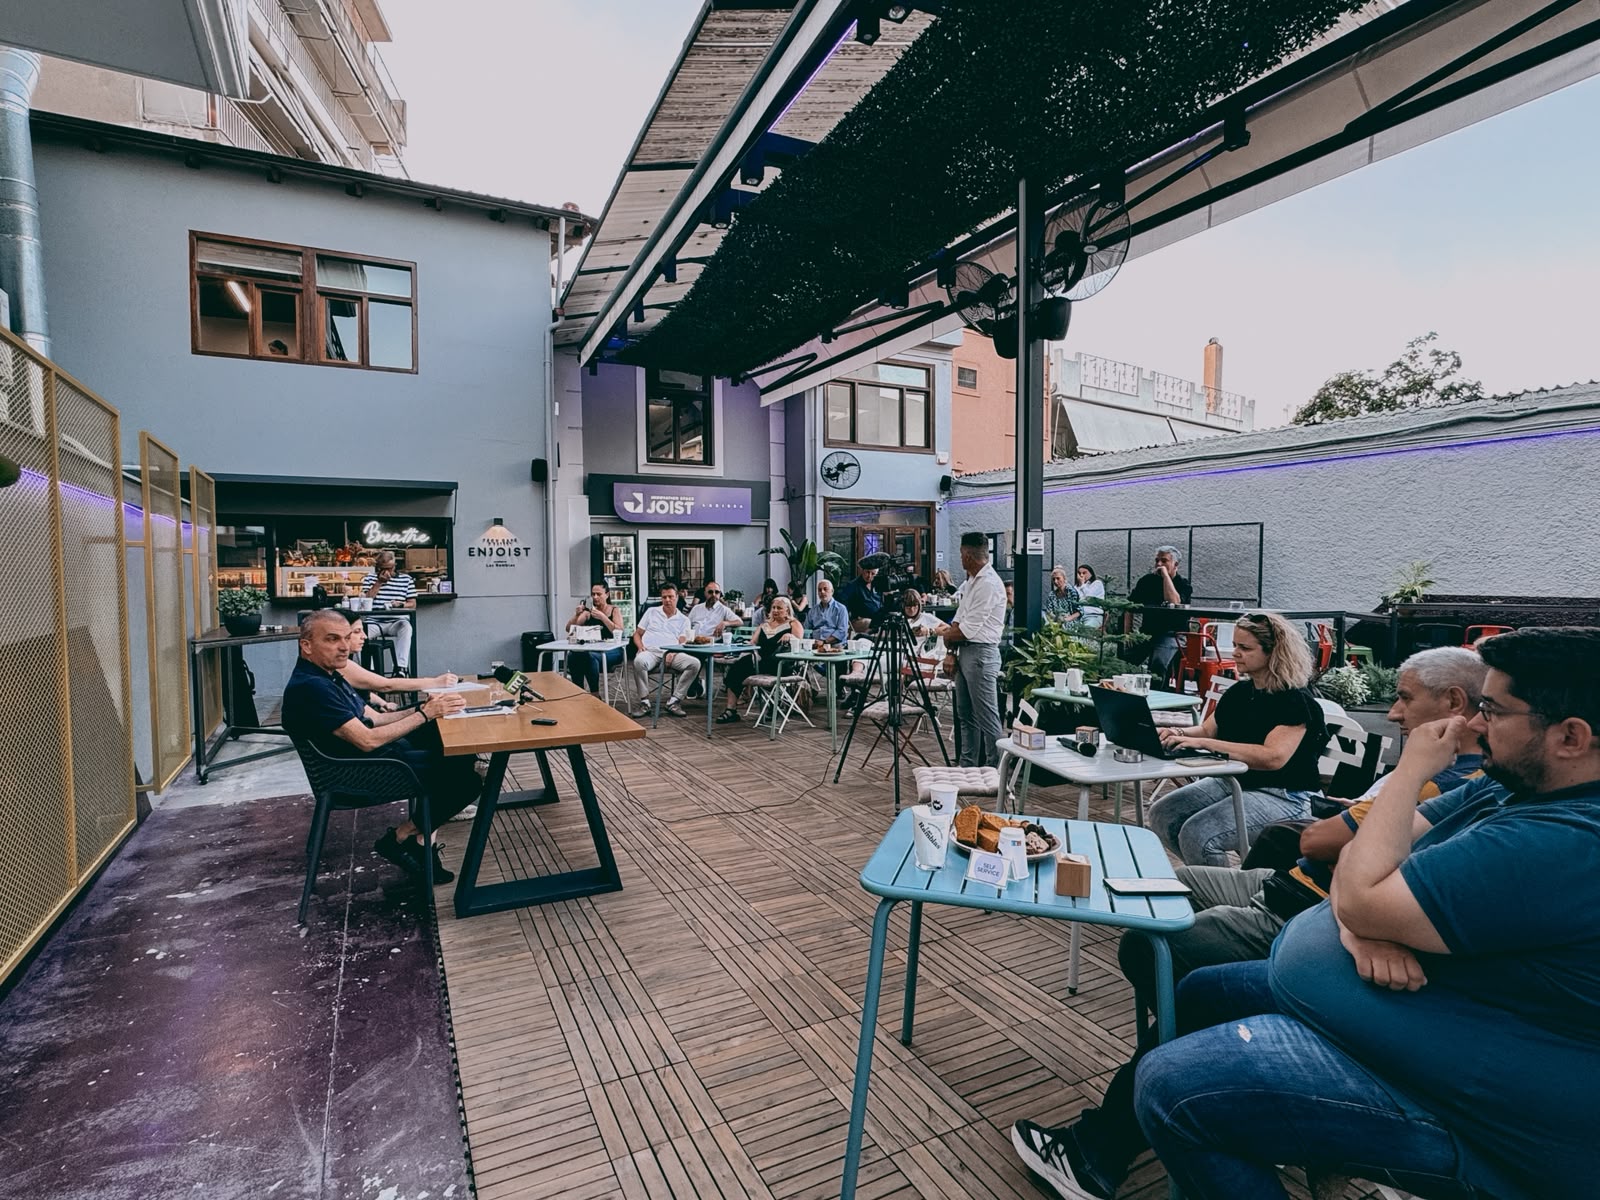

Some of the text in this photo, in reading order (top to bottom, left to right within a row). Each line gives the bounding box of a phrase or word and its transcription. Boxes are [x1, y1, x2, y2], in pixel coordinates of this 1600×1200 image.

[646, 500, 695, 515] JOIST
[363, 520, 430, 544] Breathe
[468, 547, 531, 557] ENJOIST
[977, 866, 1000, 877] SERVICE
[983, 862, 996, 870] SELF
